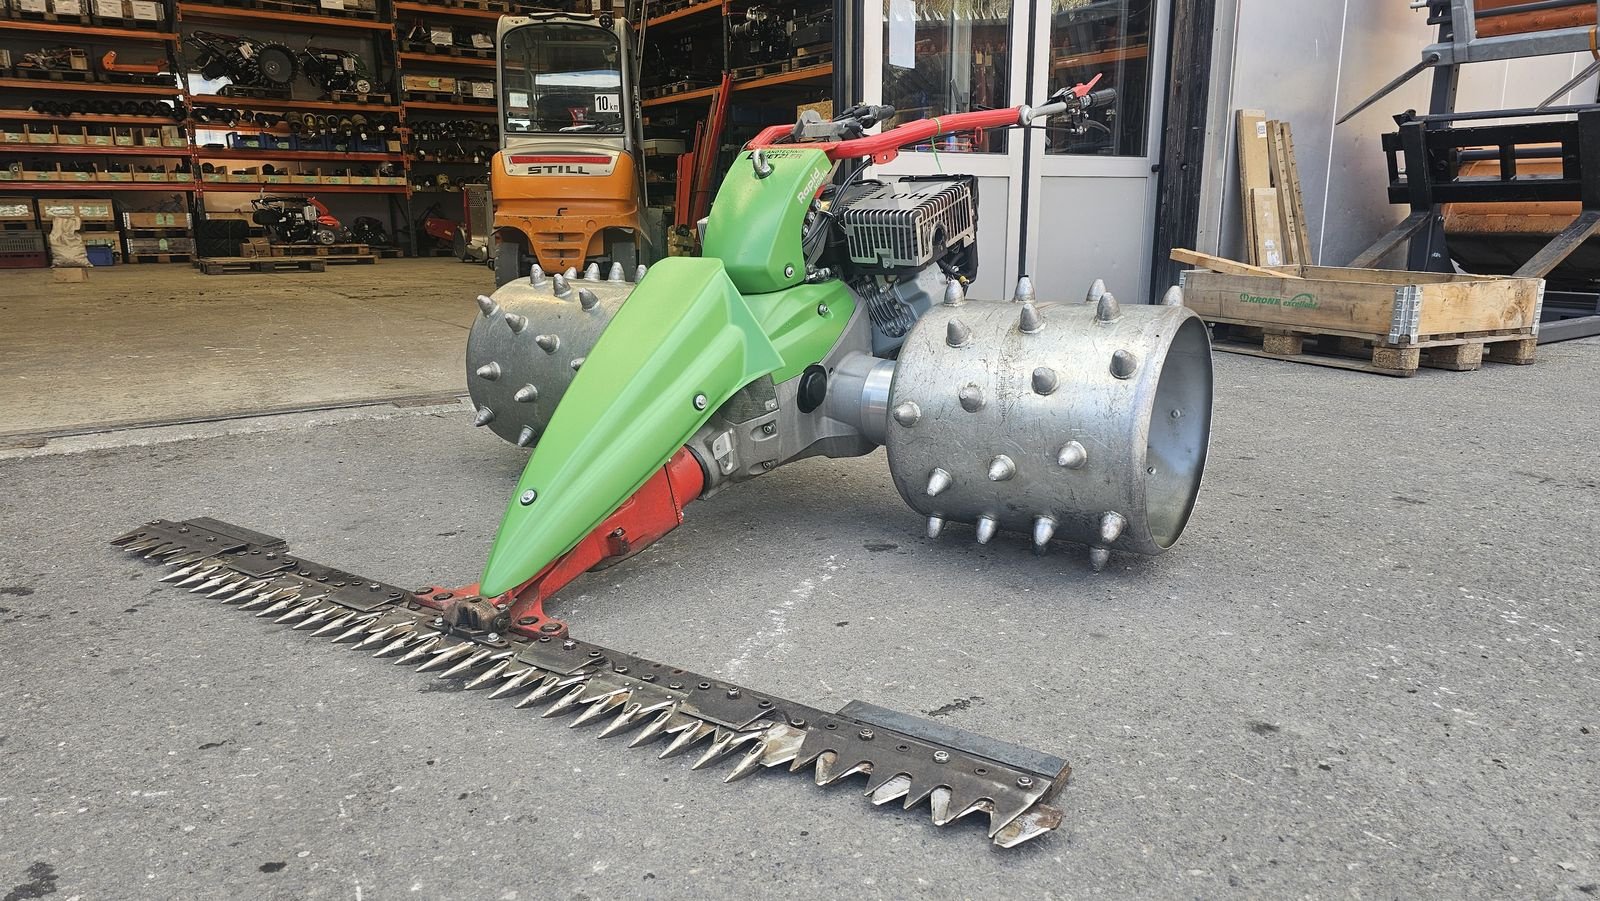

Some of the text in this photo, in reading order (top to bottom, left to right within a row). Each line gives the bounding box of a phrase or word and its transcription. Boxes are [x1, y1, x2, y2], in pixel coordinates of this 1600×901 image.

[596, 95, 619, 111] 10 km
[528, 165, 590, 174] STILL
[797, 167, 820, 204] Rapid
[1282, 300, 1318, 309] excellent
